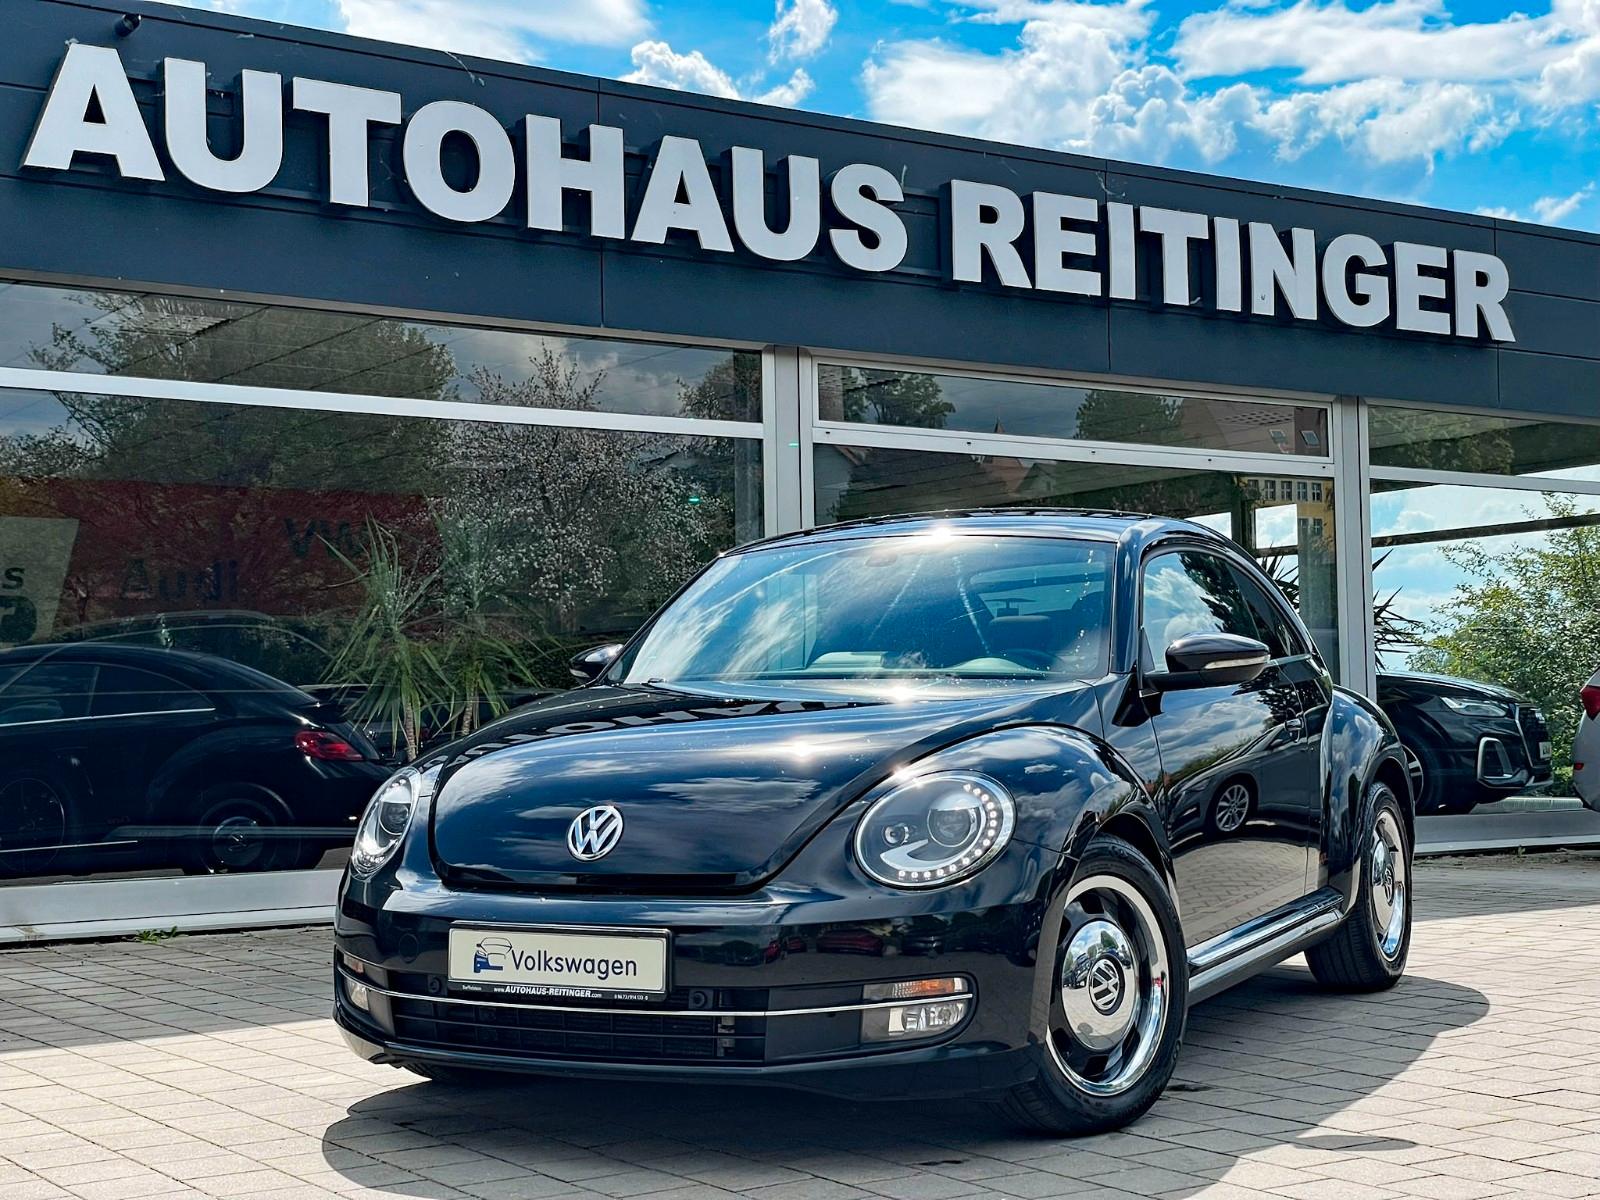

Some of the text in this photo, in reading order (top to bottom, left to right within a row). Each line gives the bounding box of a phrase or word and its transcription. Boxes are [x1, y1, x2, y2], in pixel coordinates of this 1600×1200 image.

[22, 43, 1516, 342] AUTOHAUS REITINGER
[567, 805, 623, 861] VW
[511, 949, 637, 980] Volkswagen
